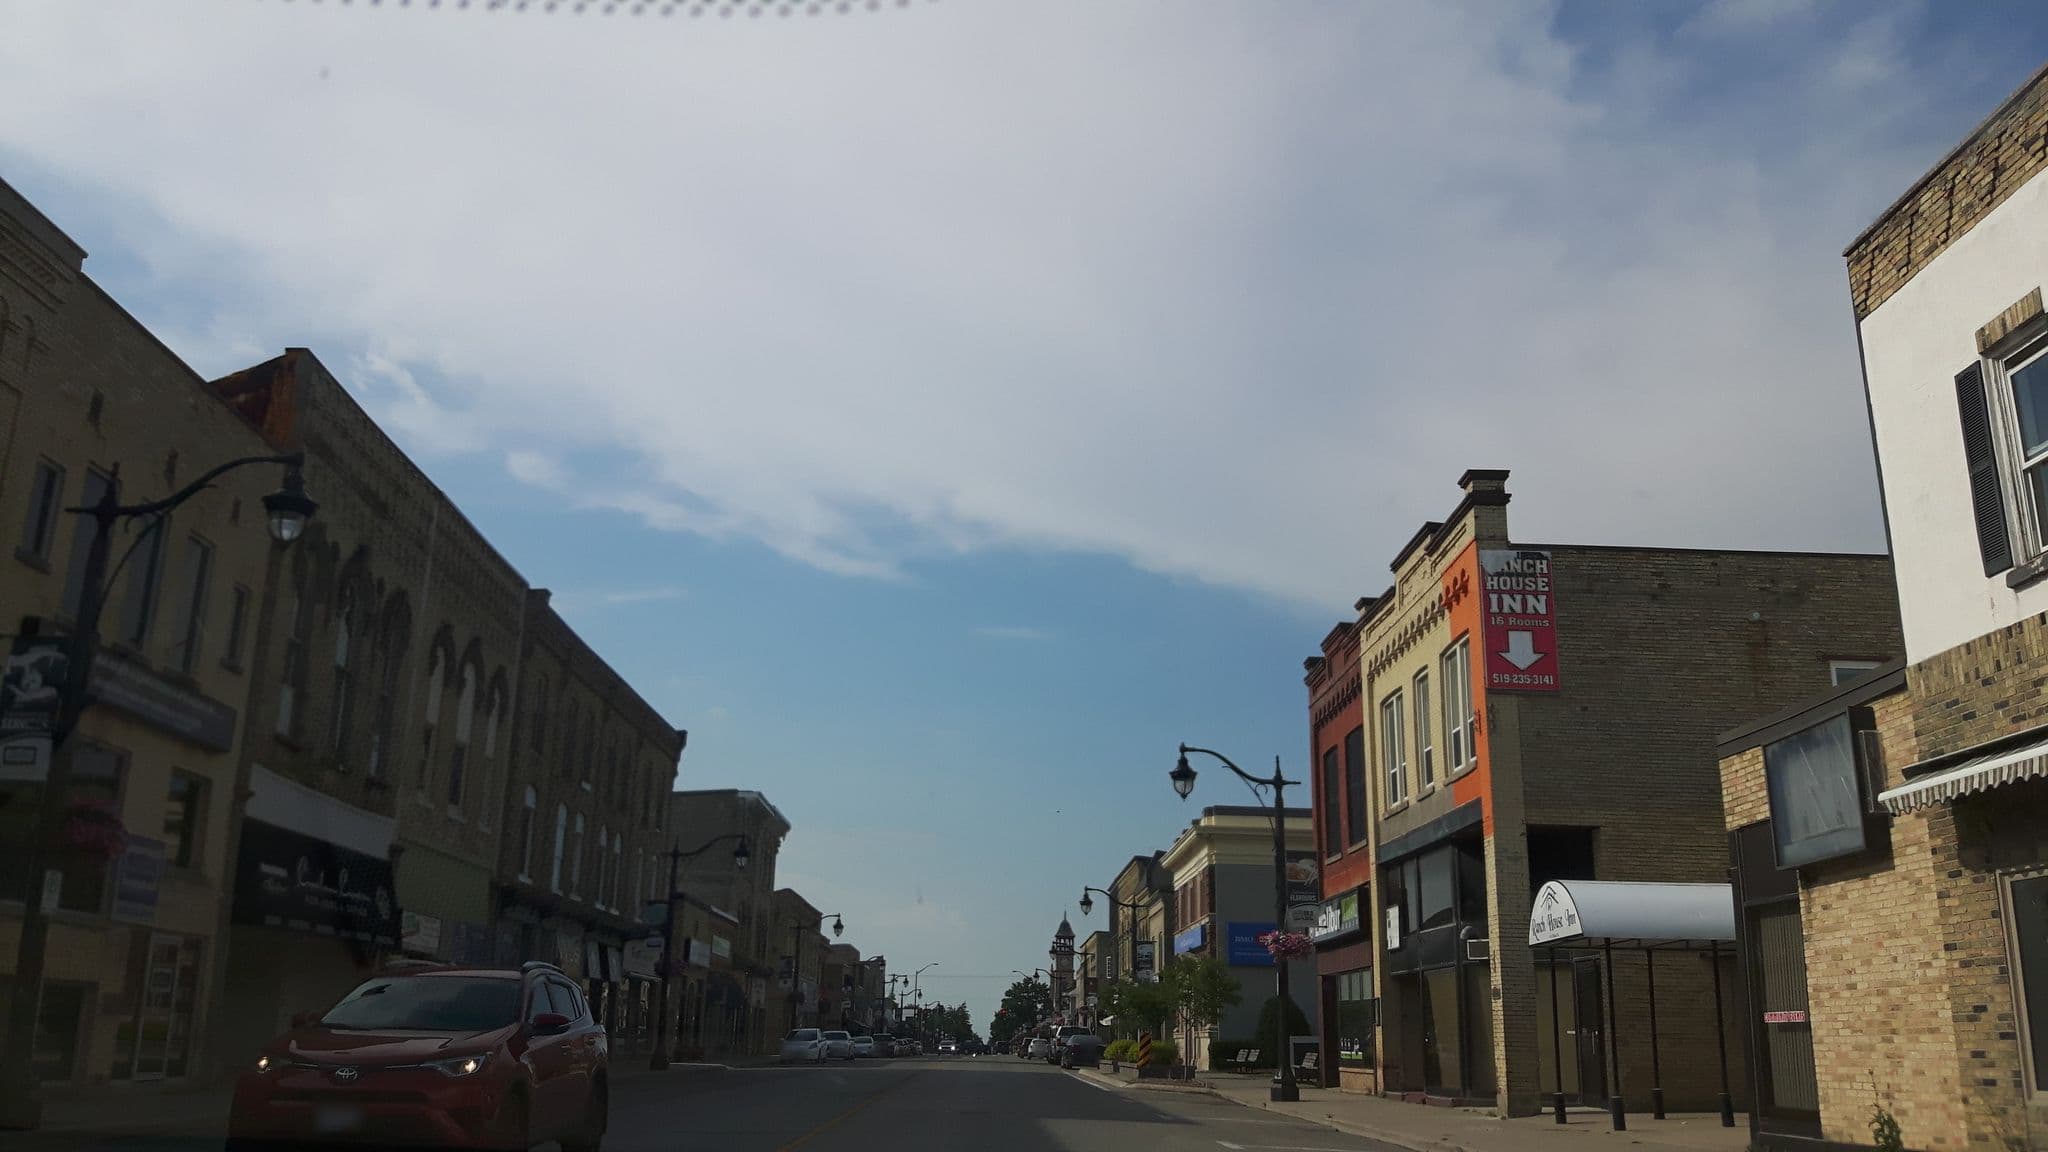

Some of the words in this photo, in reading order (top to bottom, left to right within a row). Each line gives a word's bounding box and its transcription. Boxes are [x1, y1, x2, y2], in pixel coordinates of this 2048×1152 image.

[1486, 576, 1549, 591] HOUSE
[1489, 593, 1547, 615] INN
[1491, 616, 1504, 626] 16
[1508, 617, 1550, 627] Rooms
[1493, 673, 1554, 685] 519-235-3141
[1548, 914, 1563, 931] House
[1565, 908, 1577, 927] Inn
